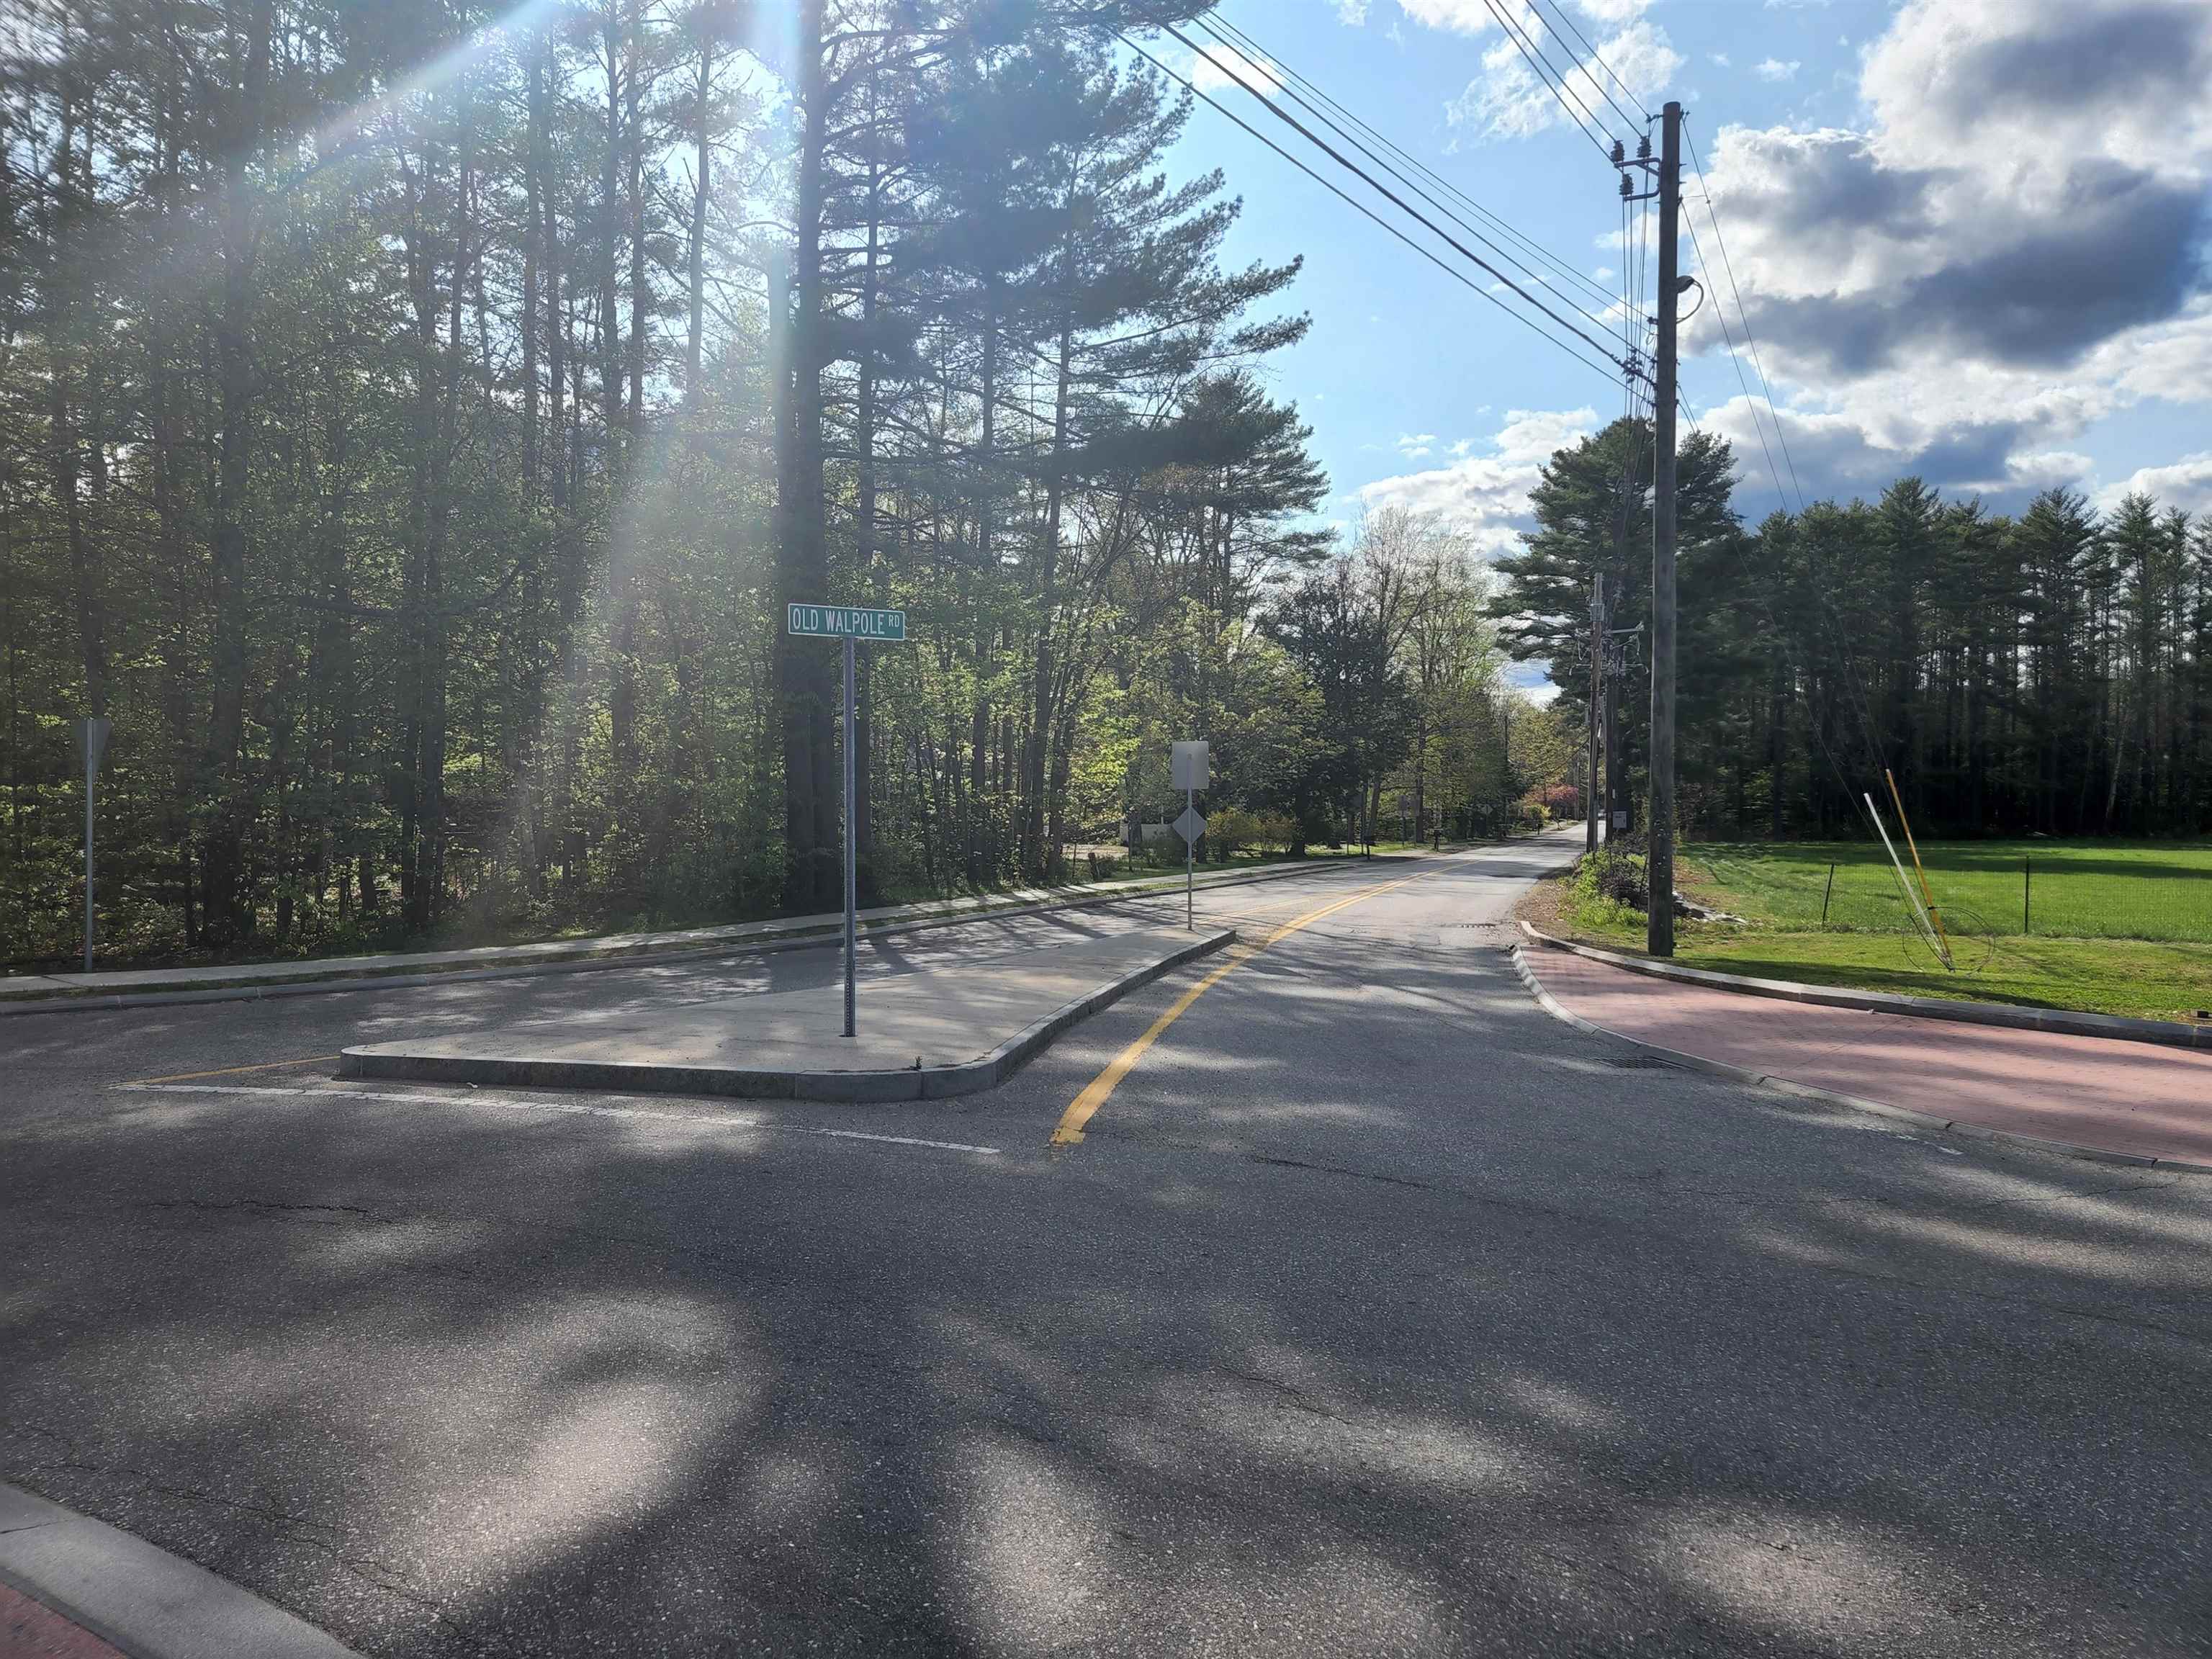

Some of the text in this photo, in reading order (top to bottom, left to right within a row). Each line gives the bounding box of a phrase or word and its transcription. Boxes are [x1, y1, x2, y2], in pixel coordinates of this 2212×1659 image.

[792, 608, 899, 634] OLD WALPOLE RD
